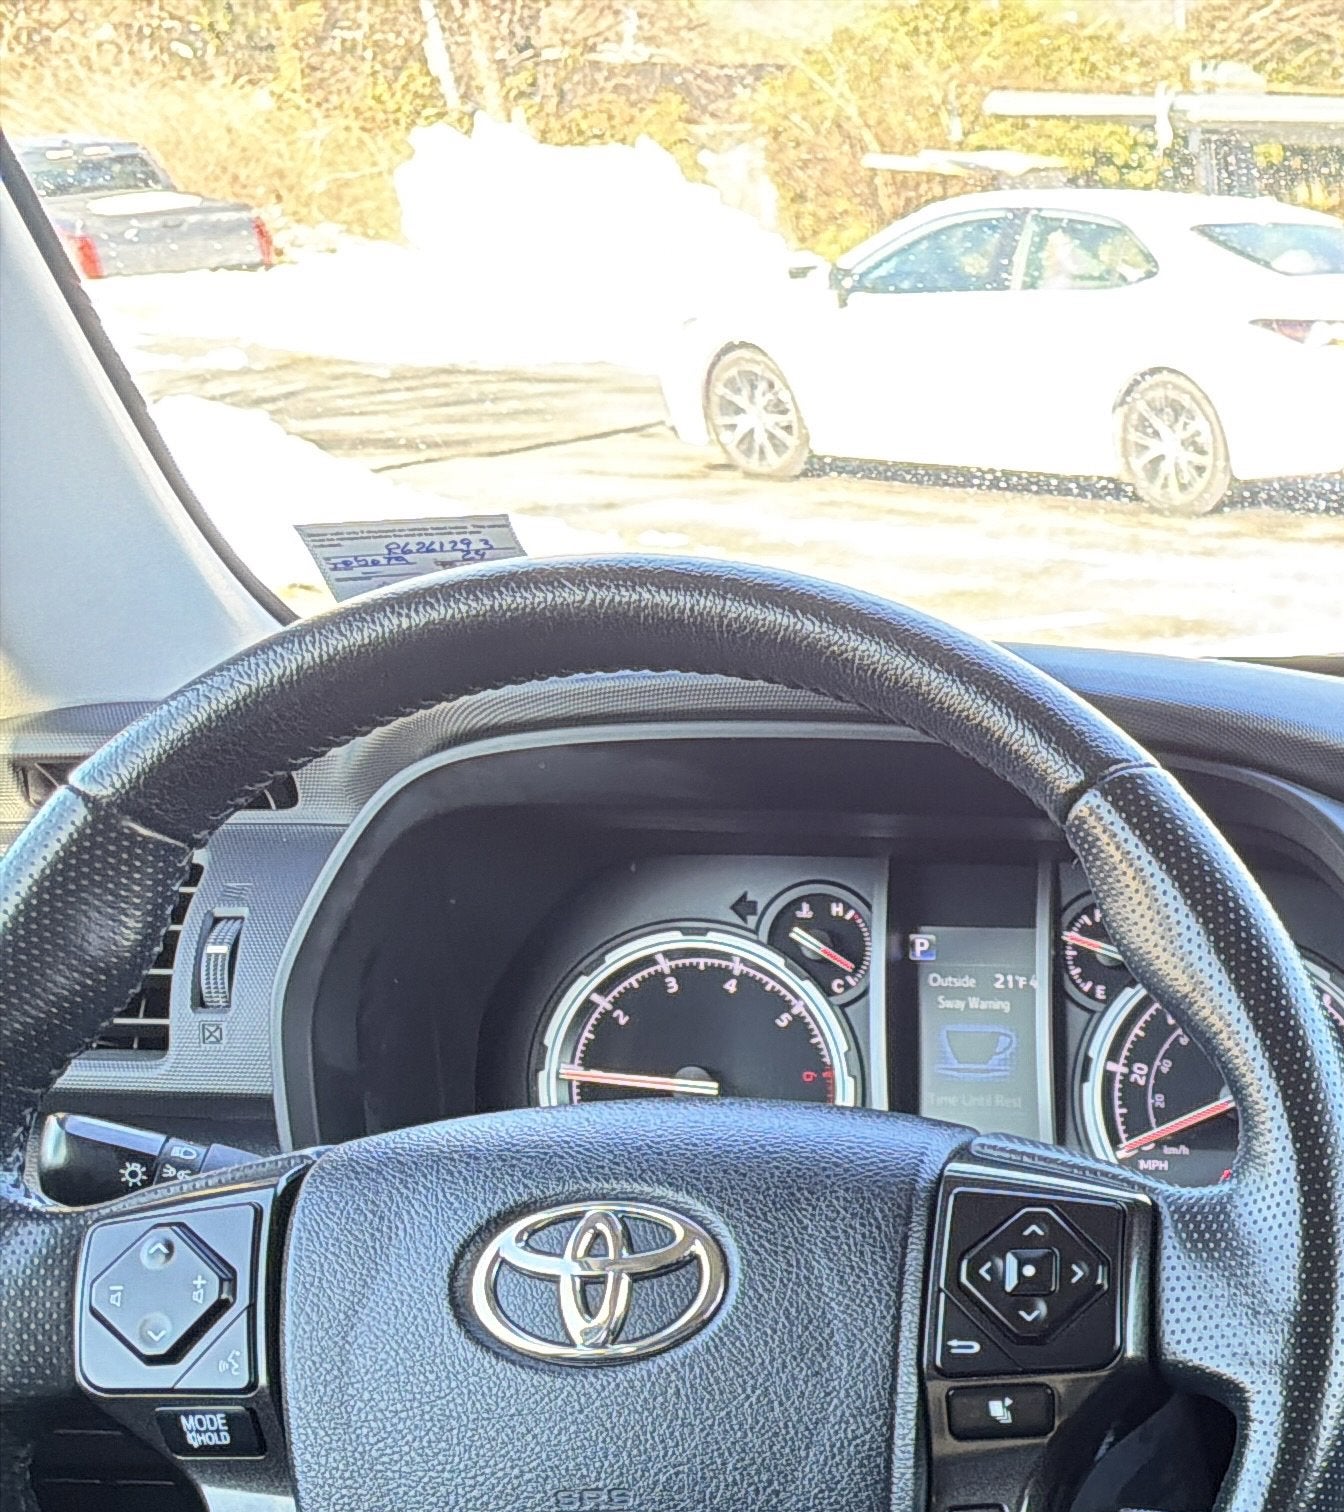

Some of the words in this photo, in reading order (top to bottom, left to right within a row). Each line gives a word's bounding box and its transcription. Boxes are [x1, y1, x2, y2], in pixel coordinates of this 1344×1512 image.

[831, 902, 845, 917] H
[665, 977, 679, 994] 3
[723, 980, 738, 995] 4
[831, 978, 845, 993] C
[928, 972, 977, 988] Outside
[937, 995, 966, 1011] Sway
[968, 997, 1011, 1013] Warning
[612, 1008, 630, 1027] 2
[775, 1012, 793, 1029] 5
[1129, 1062, 1149, 1086] 20
[1138, 1159, 1169, 1171] MPH
[181, 1413, 228, 1431] MODE
[199, 1431, 230, 1445] HOLD
